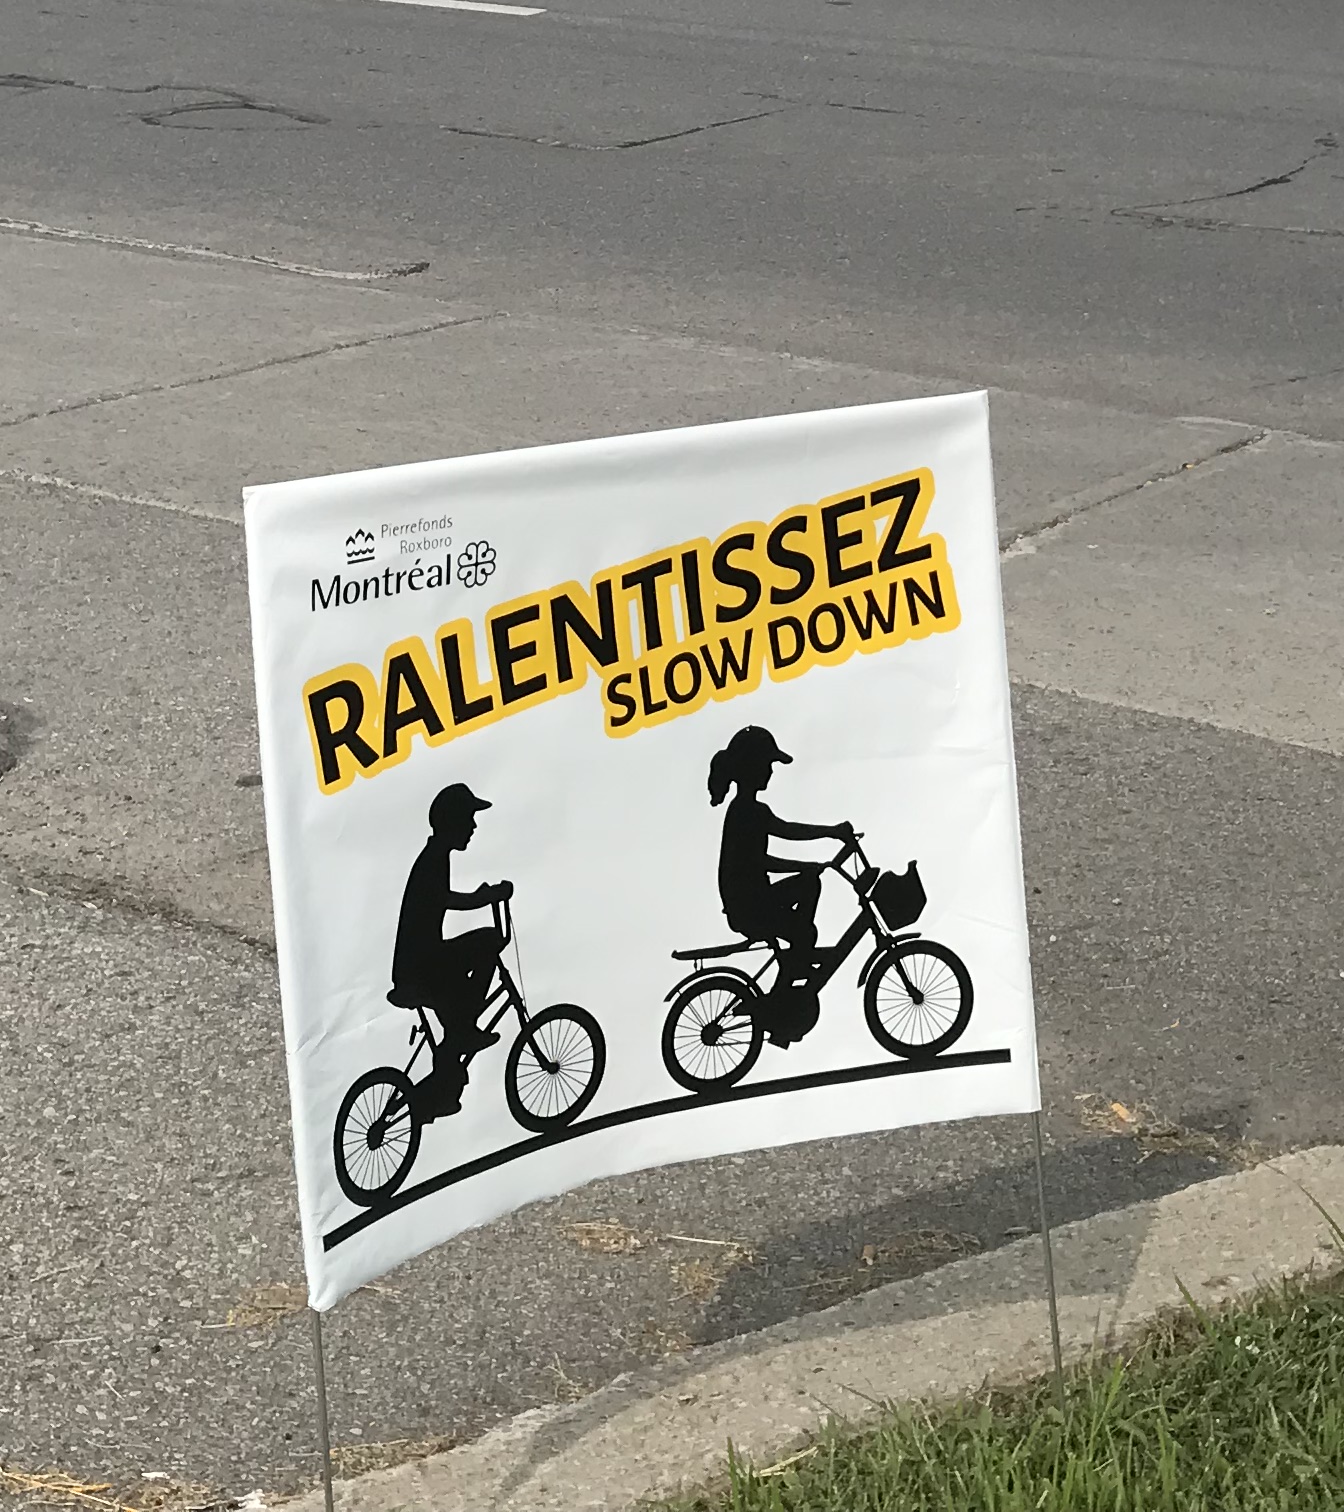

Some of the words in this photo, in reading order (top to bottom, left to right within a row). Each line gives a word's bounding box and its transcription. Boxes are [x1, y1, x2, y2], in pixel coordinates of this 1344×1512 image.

[381, 514, 454, 538] Pierrefonds
[400, 535, 453, 555] Roxboro
[311, 553, 452, 612] Montréal
[307, 477, 932, 786] RALENTISSEZ
[606, 628, 754, 727] SLOW
[767, 570, 946, 670] DOWN
